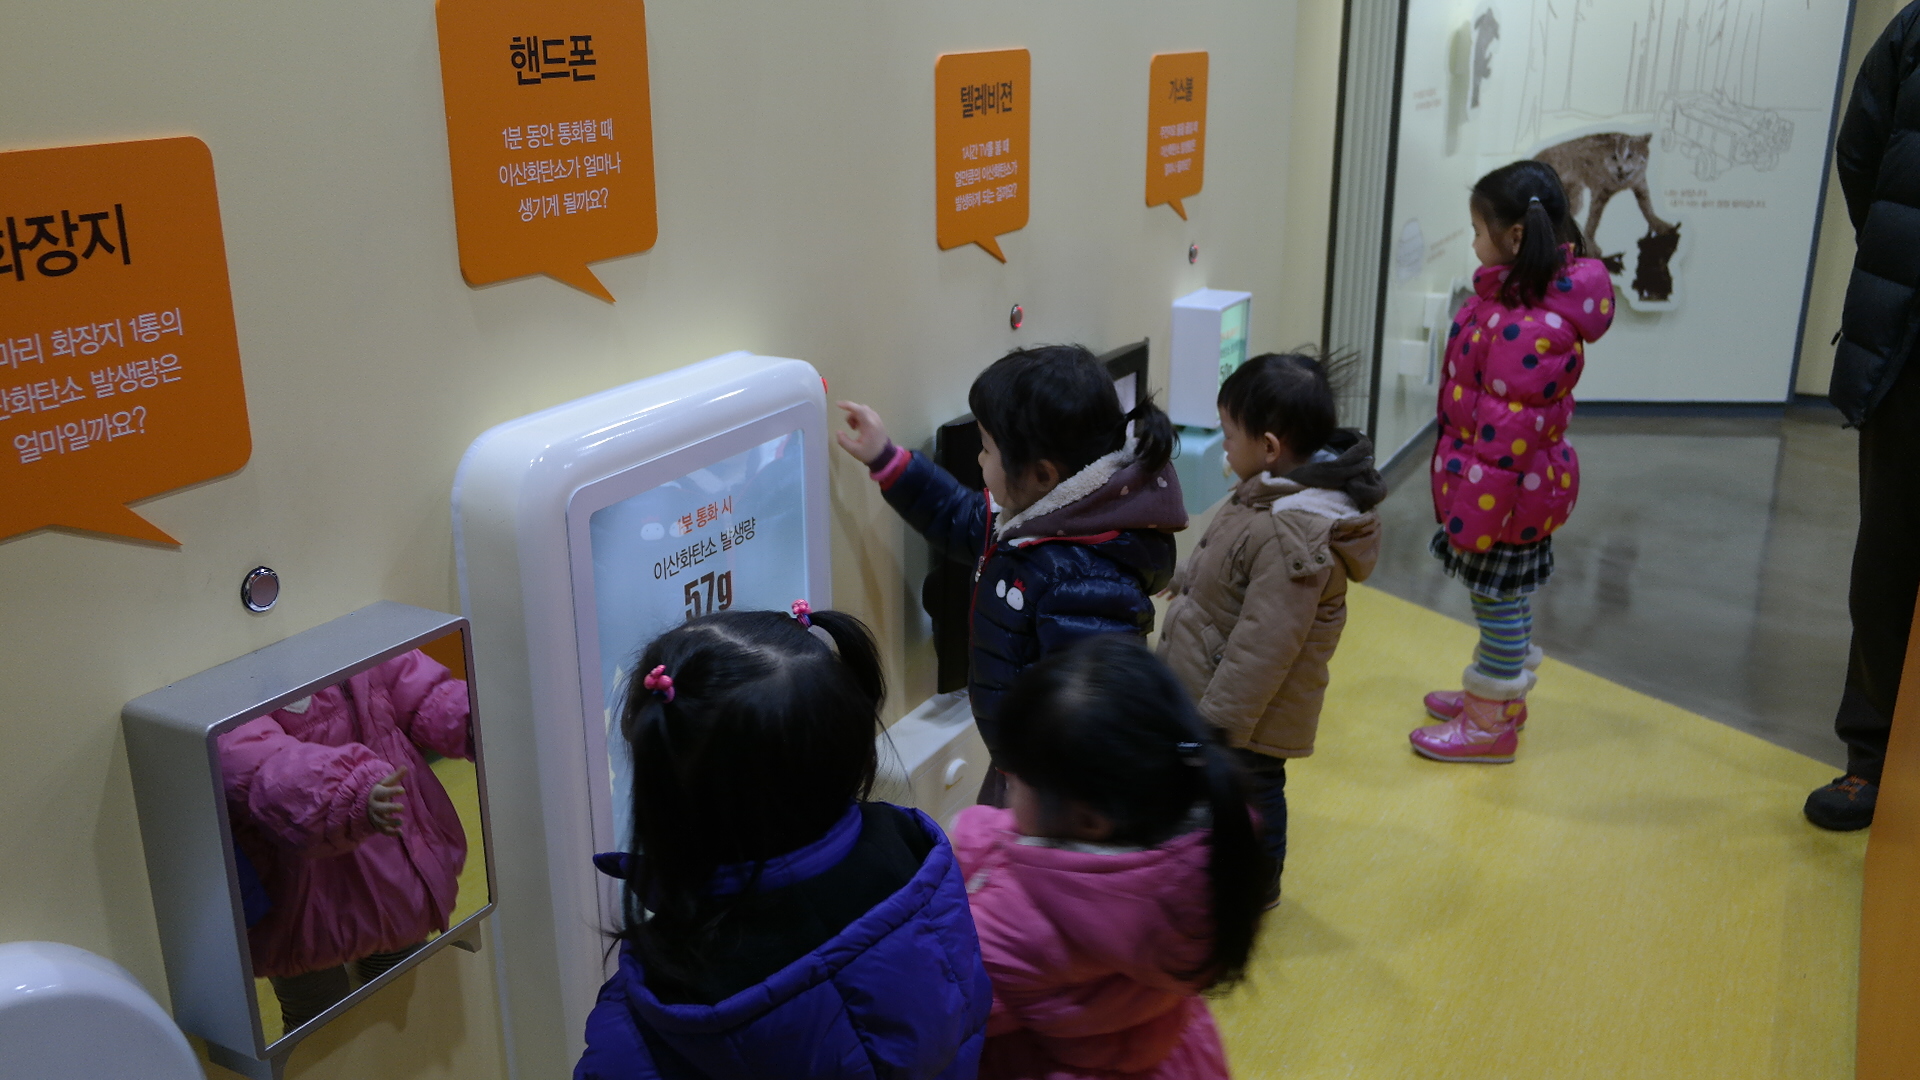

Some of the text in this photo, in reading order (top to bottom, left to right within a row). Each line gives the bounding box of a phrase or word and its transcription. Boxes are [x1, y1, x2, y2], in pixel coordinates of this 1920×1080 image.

[510, 35, 596, 85] 핸드폰
[960, 80, 1013, 119] 텔레비젼
[502, 117, 614, 150] 1분 동안 통화할 때
[499, 151, 621, 187] 이산화탄소가 얼마나
[518, 187, 610, 222] 생기게 될까요?
[51, 318, 124, 359] 화장지
[128, 307, 184, 343] 1통의
[91, 353, 182, 399] 발생량은
[14, 405, 148, 464] 얼마일까요?
[696, 502, 718, 528] 통화
[721, 495, 733, 515] 시
[653, 516, 756, 580] 이산화탄소 발생량
[684, 570, 733, 621] 57g
